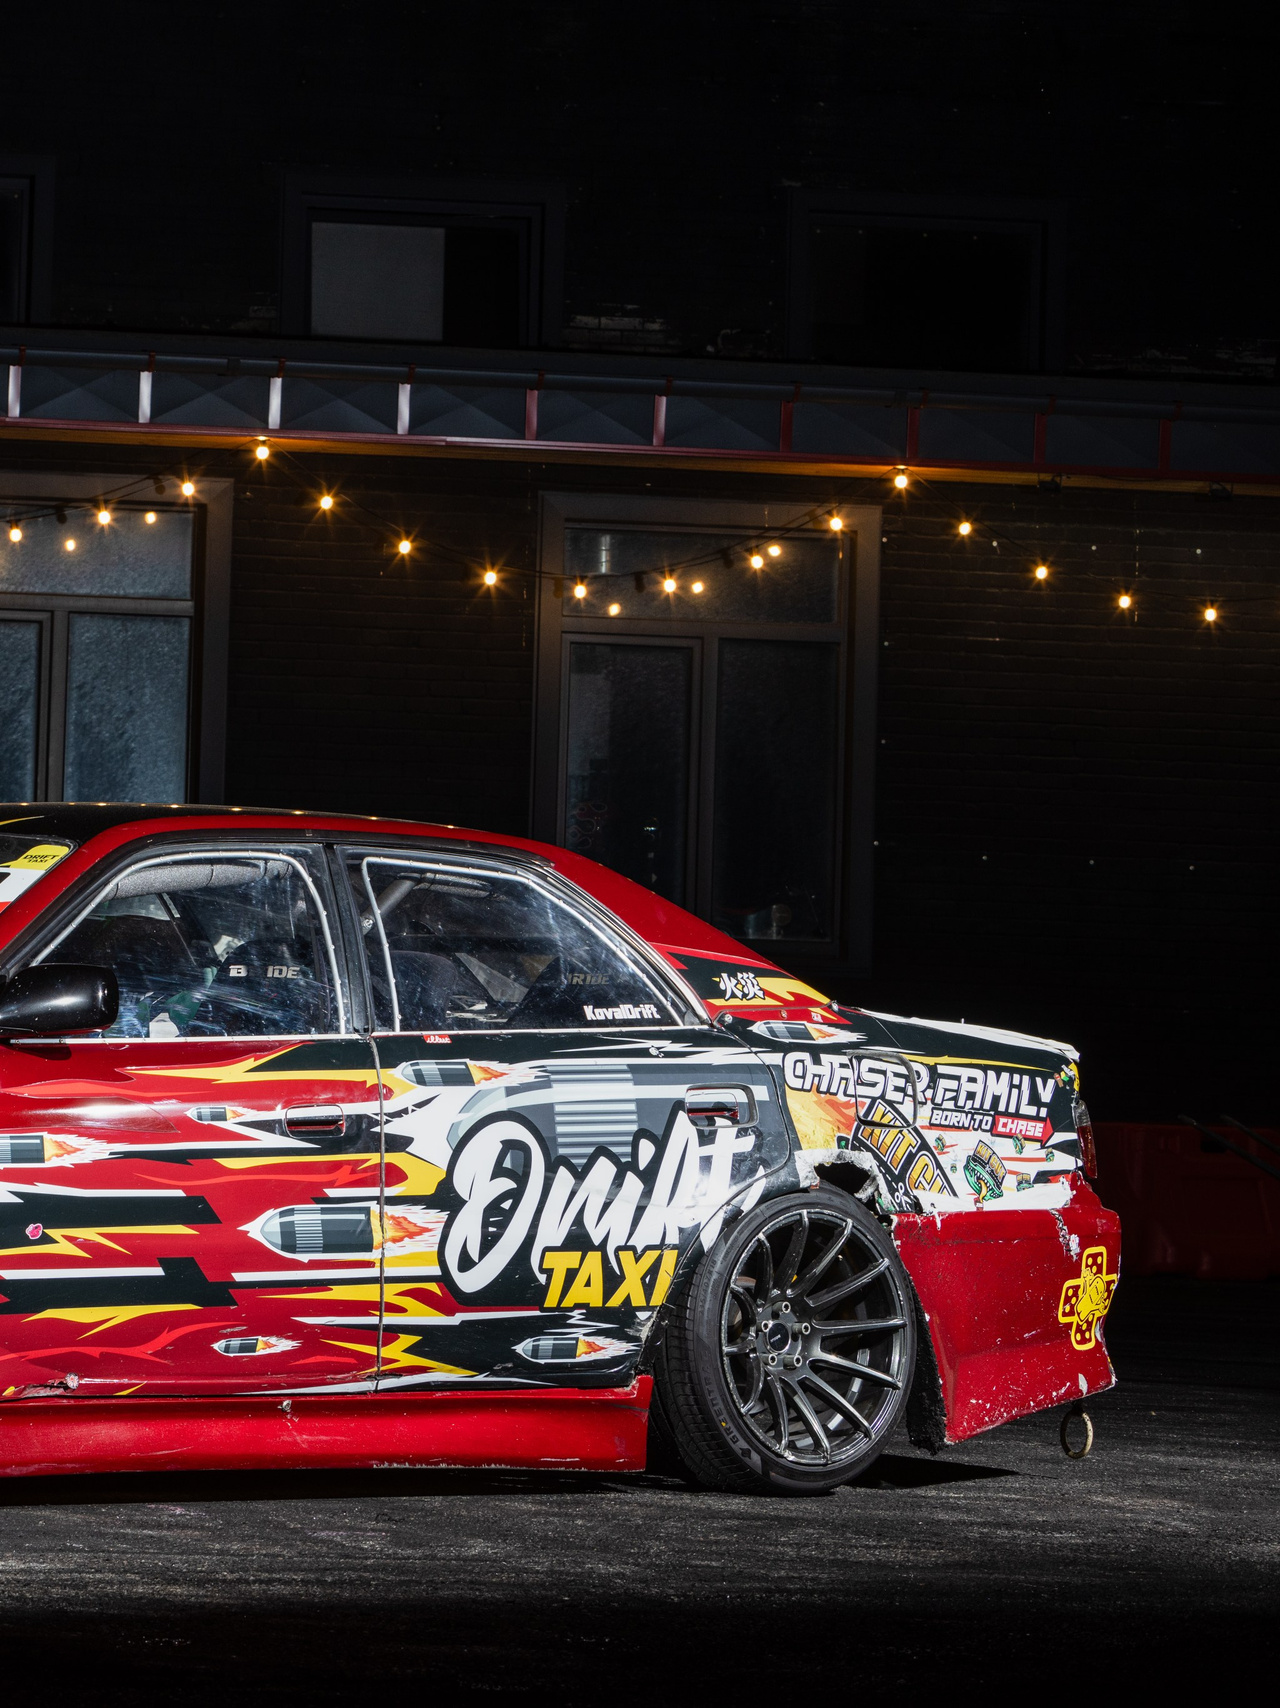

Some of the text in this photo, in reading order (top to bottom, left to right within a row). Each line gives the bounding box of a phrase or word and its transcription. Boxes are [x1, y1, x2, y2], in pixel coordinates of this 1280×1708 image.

[228, 965, 300, 979] BIDE
[719, 972, 765, 1000] 火災
[583, 1004, 661, 1020] KovalDrift
[784, 1052, 931, 1104] CHASER
[861, 1101, 919, 1172] KIT
[931, 1109, 1045, 1138] BORN TO CHASE
[445, 1110, 766, 1293] Drift
[542, 1249, 679, 1308] TAXI
